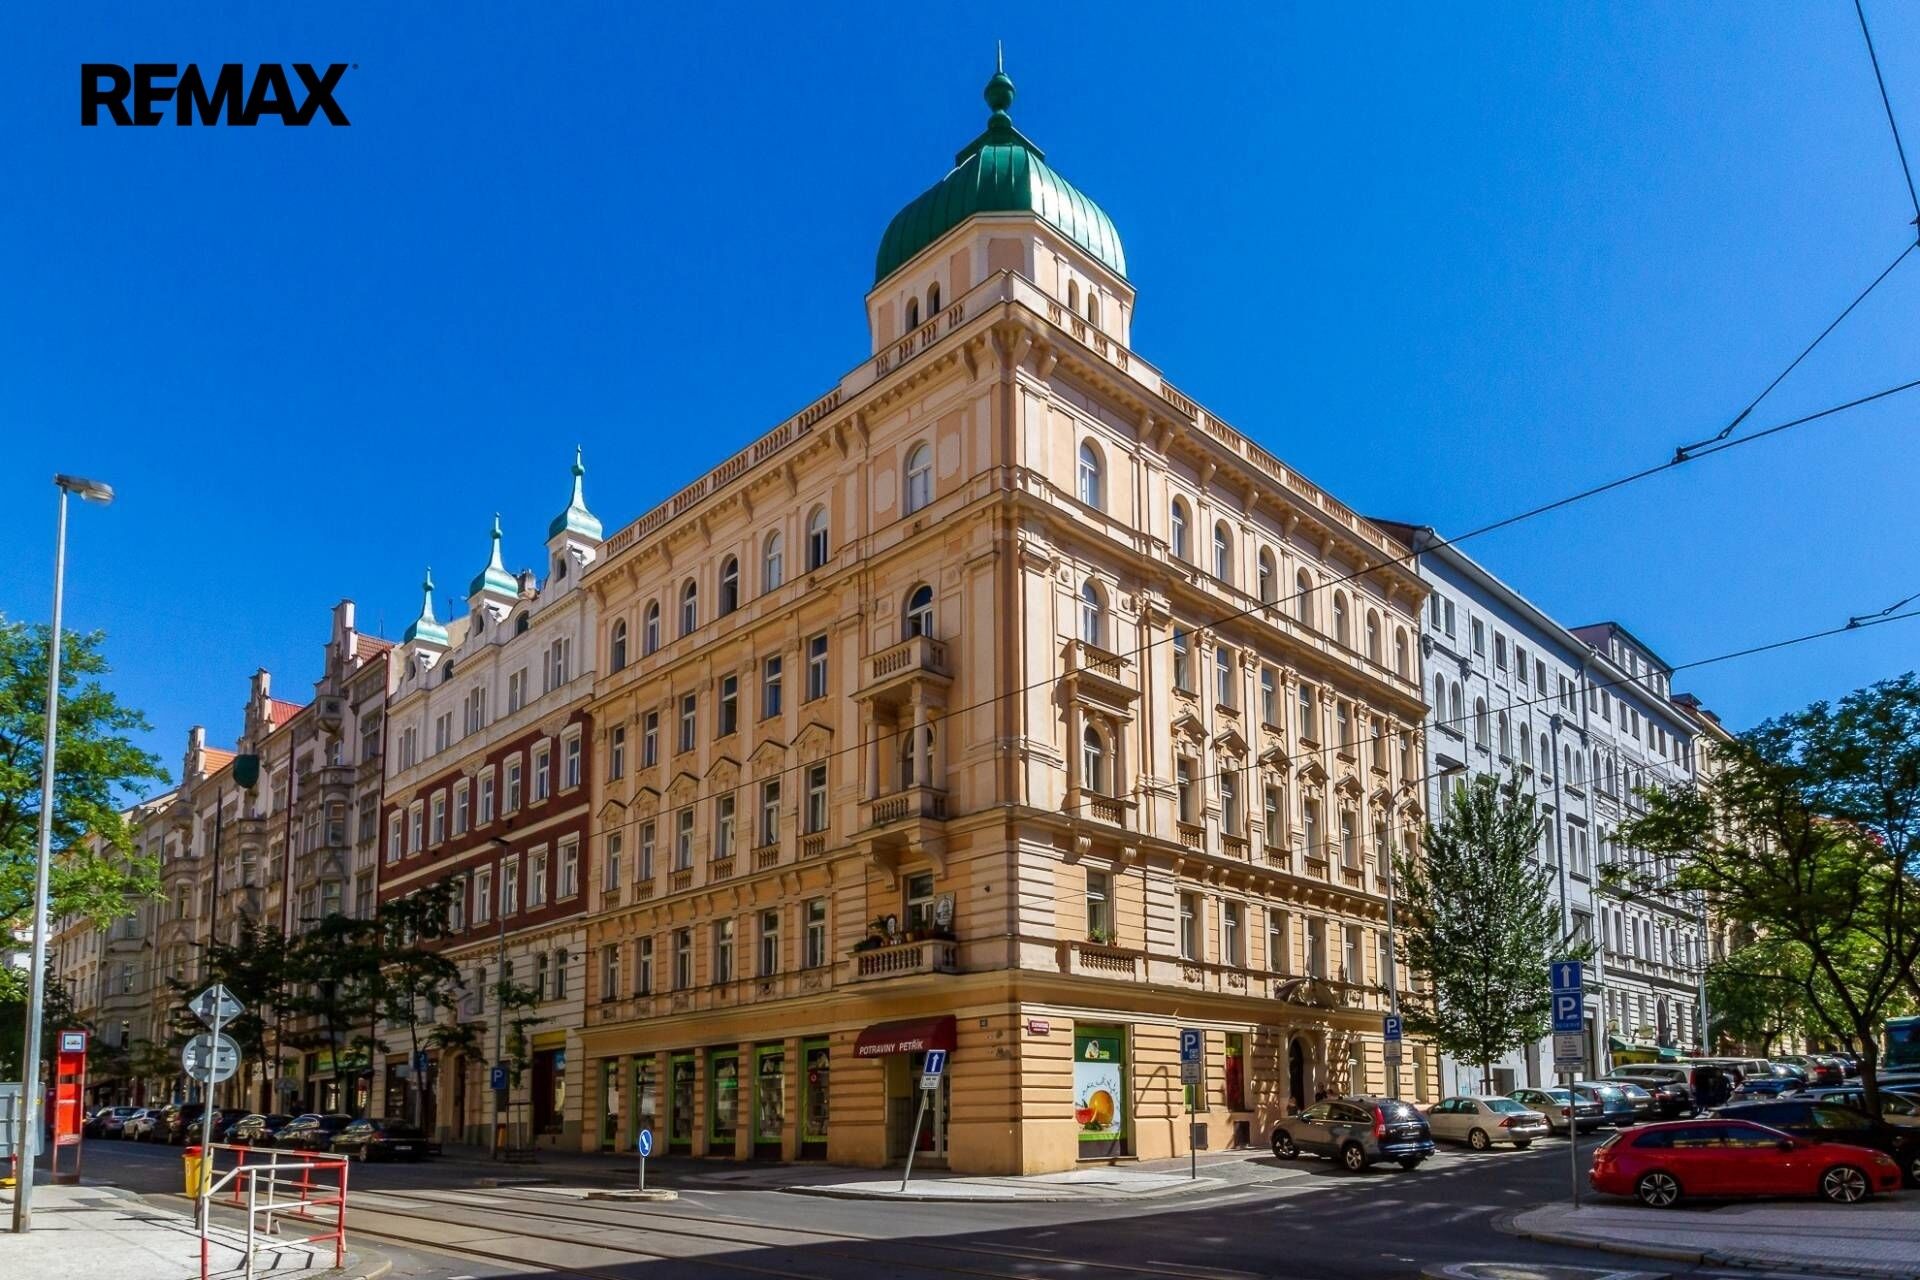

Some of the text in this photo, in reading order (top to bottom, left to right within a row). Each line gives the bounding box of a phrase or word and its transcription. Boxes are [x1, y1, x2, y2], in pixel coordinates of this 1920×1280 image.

[1559, 997, 1576, 1020] P
[1387, 1019, 1397, 1034] P
[859, 1042, 896, 1056] POTRAVINY
[1185, 1034, 1196, 1052] P
[494, 1069, 503, 1083] P
